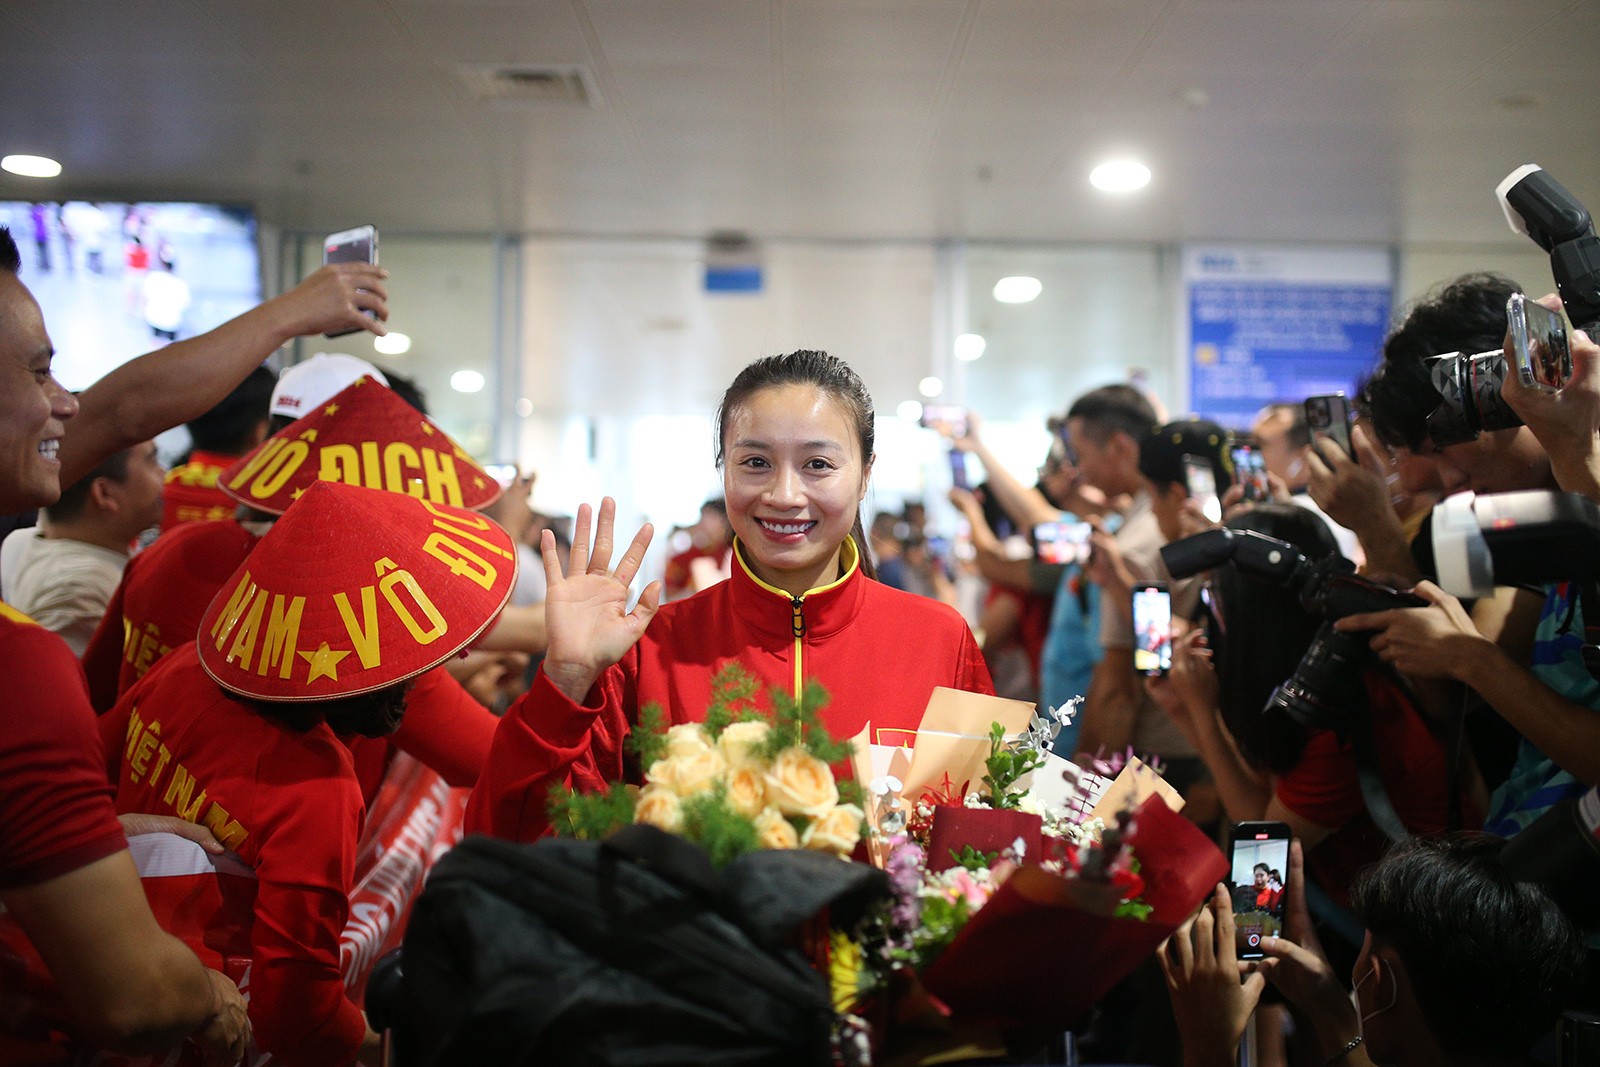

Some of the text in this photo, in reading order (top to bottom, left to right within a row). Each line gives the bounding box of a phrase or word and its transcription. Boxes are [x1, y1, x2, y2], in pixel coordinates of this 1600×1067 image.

[228, 428, 318, 498] VÔ
[211, 569, 306, 679] NAM
[333, 556, 448, 670] VÔ
